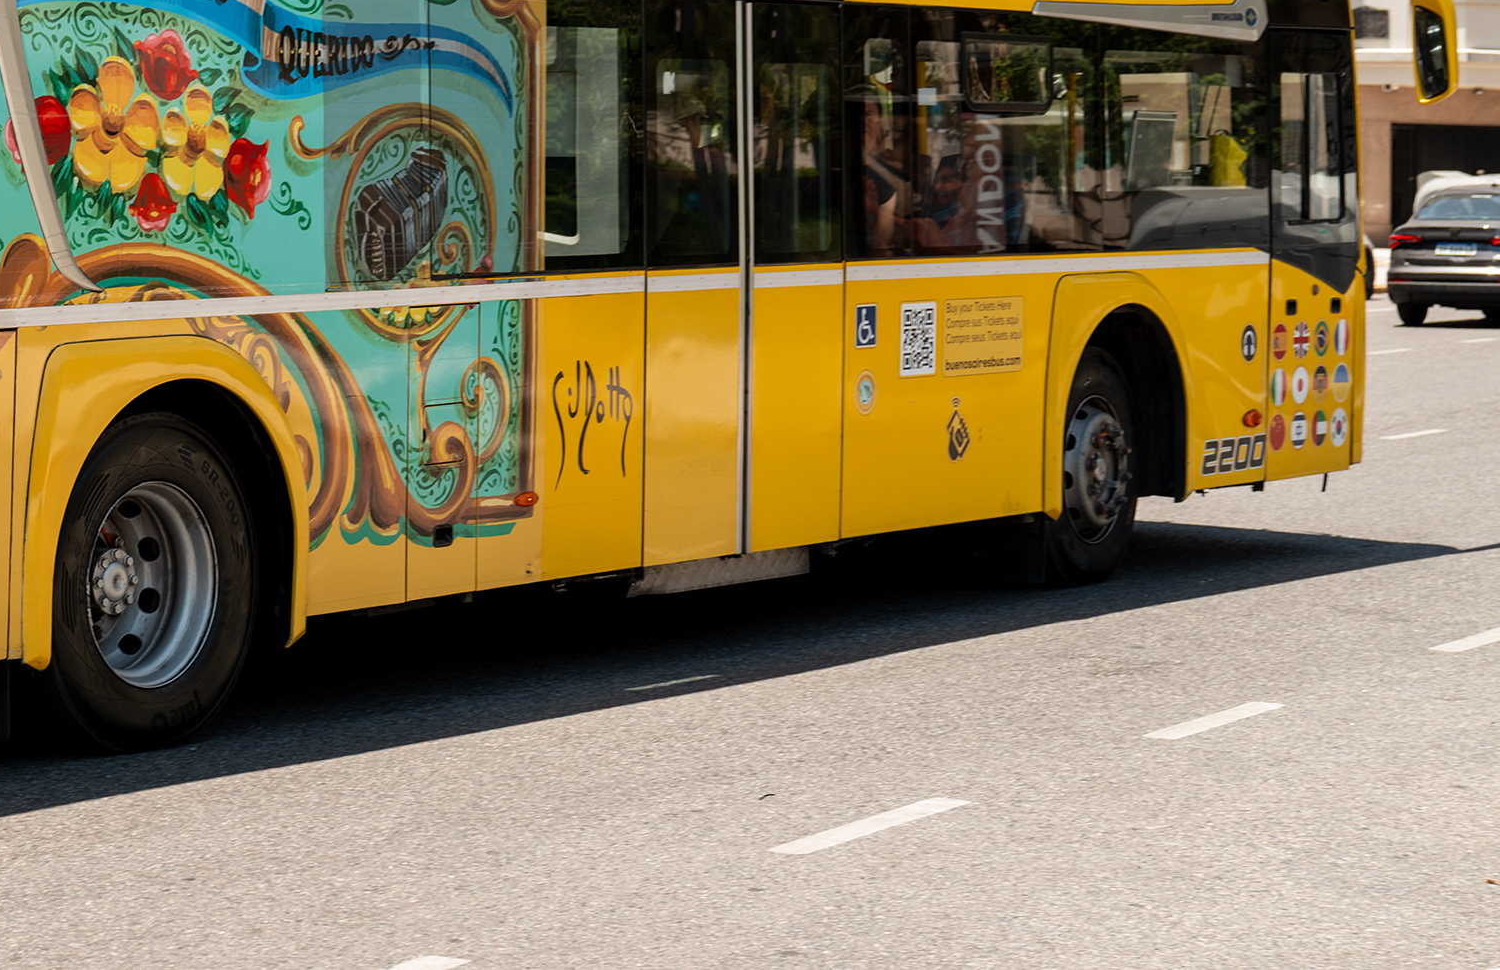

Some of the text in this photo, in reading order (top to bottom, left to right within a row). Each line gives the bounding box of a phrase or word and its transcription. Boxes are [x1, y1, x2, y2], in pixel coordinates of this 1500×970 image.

[277, 24, 375, 85] QUERIDO
[945, 301, 1012, 315] Buy your Tickets Here
[945, 318, 970, 329] Compre
[971, 318, 983, 327] sus
[984, 316, 1005, 326] Tickets
[945, 333, 970, 345] Compre
[987, 330, 1008, 341] Tickets
[945, 355, 1021, 371] buenosairesbus.com
[1201, 433, 1267, 477] 2200
